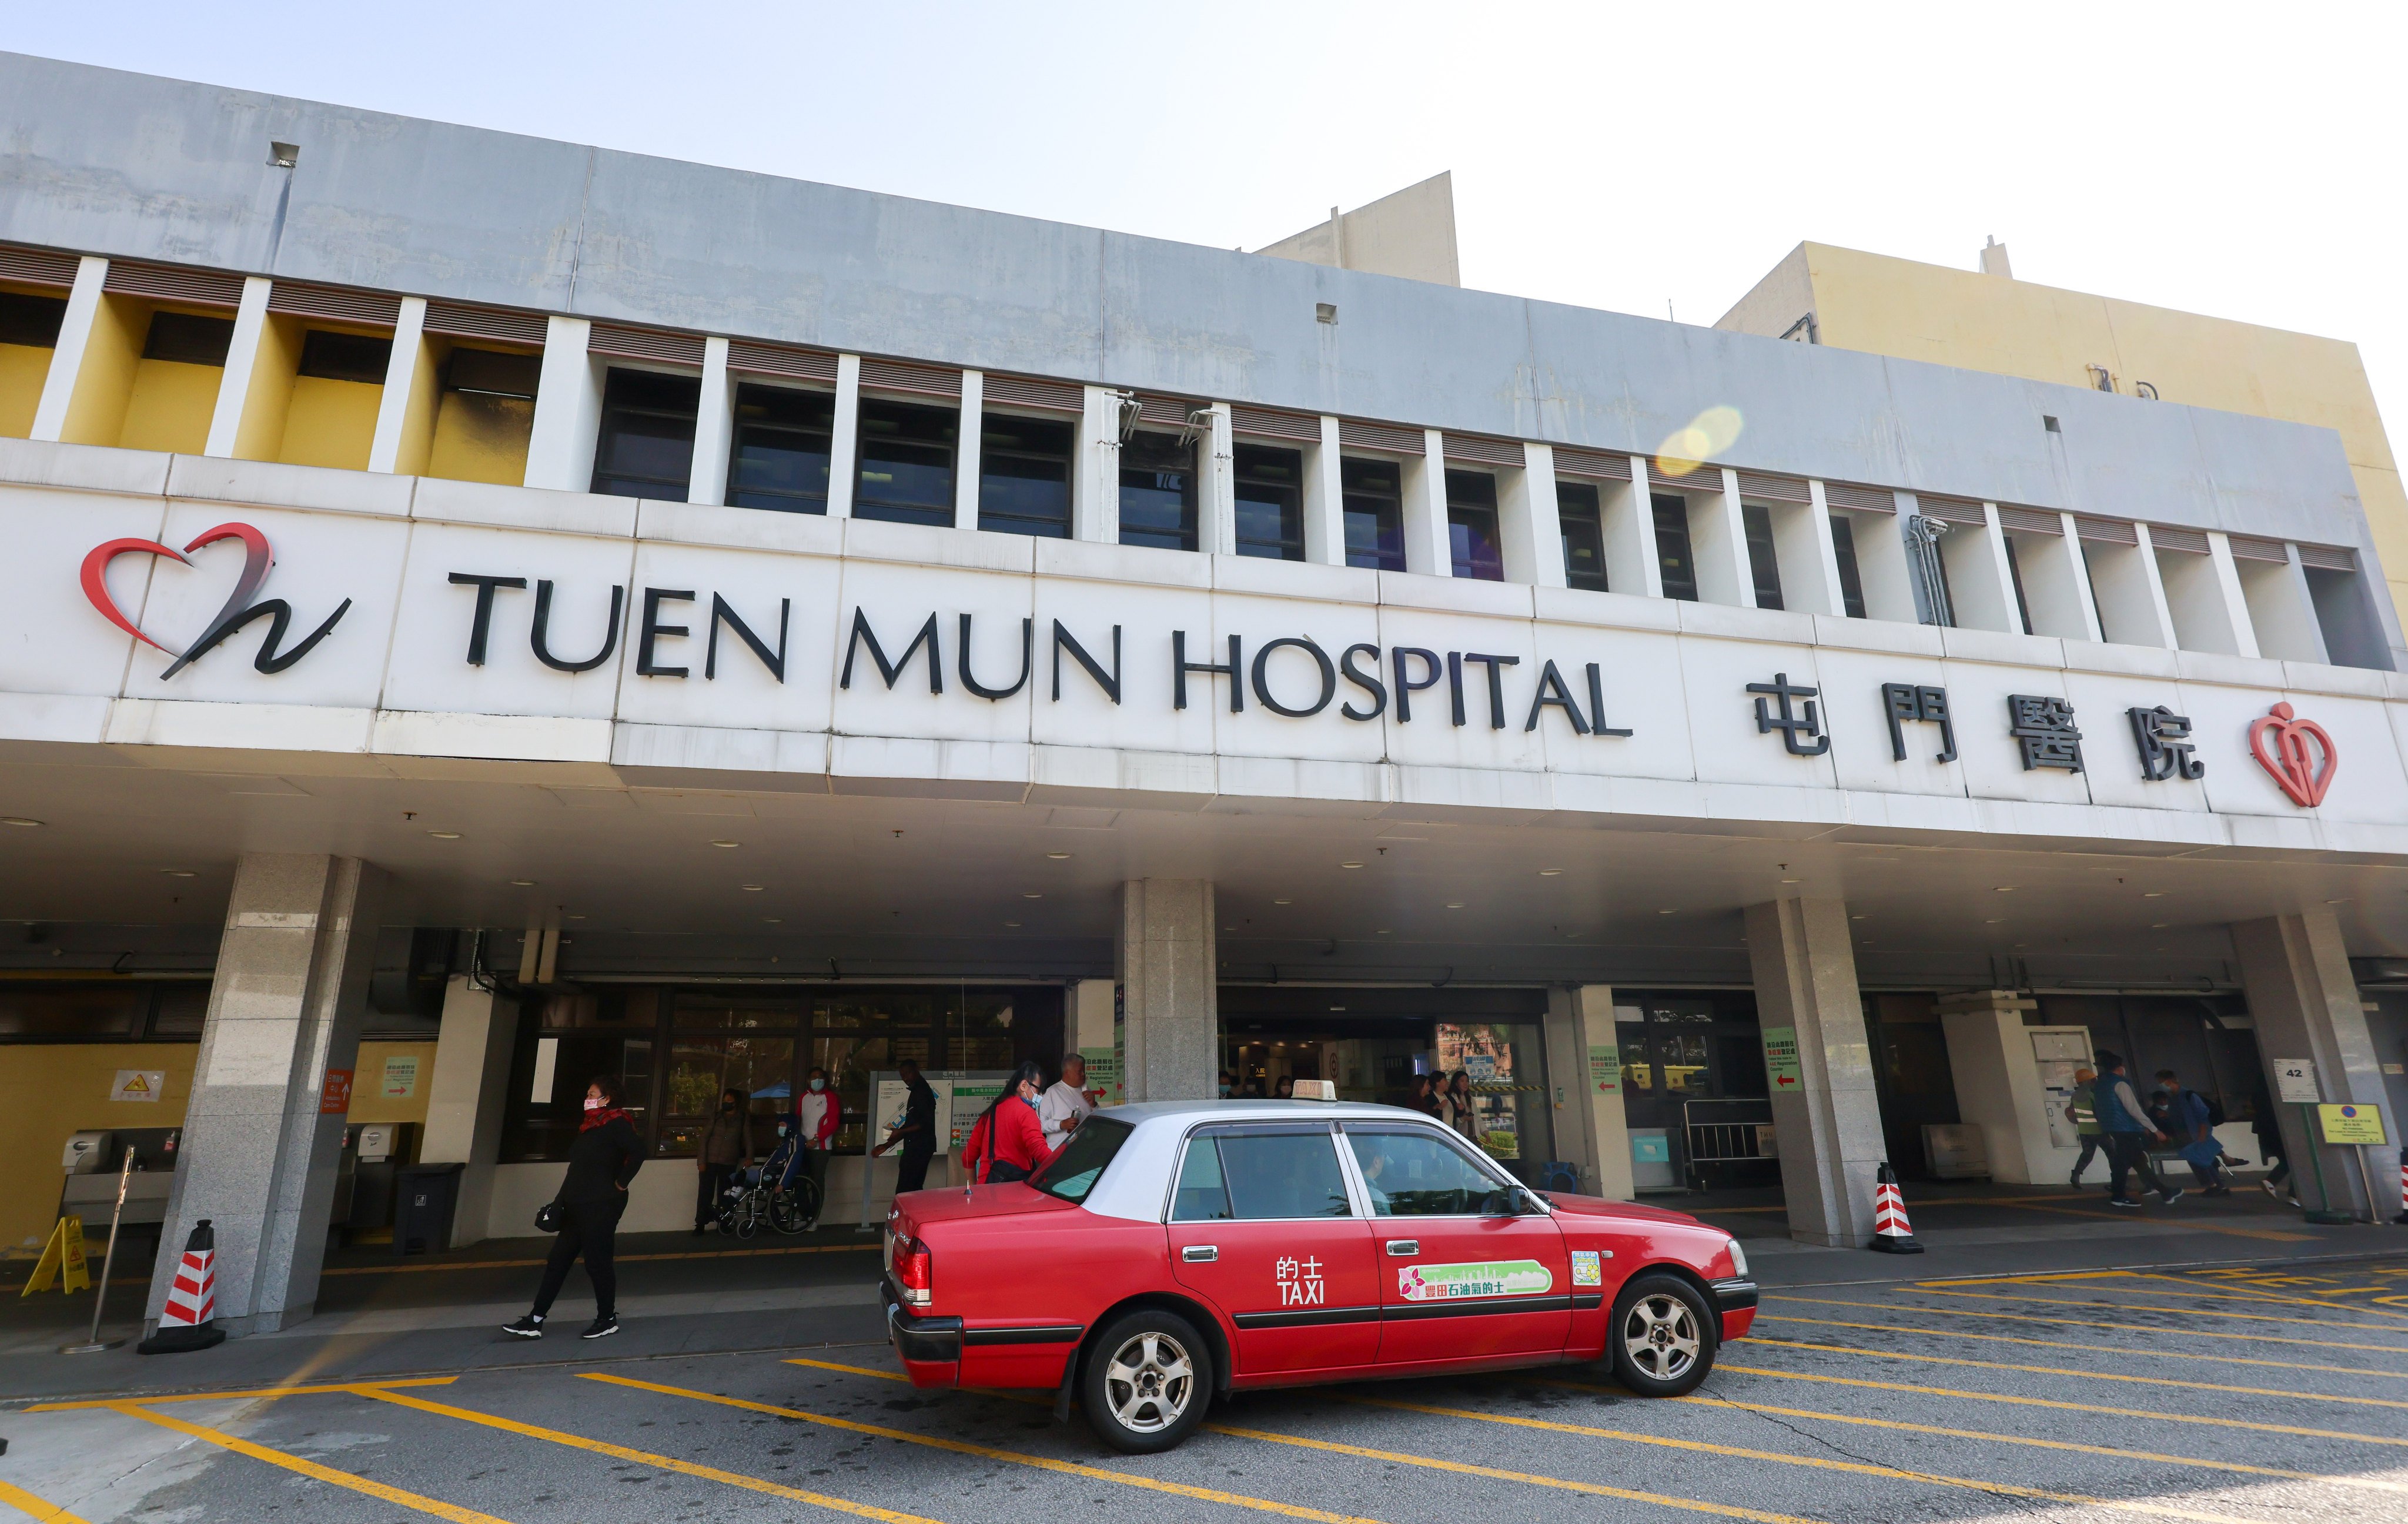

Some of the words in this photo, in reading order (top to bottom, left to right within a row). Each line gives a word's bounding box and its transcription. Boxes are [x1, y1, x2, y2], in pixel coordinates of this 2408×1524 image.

[447, 572, 790, 684] TUEN
[840, 606, 1121, 706] MUN
[1172, 630, 1634, 738] HOSPITAL
[1745, 673, 2205, 782] 屯門醫院
[1295, 1082, 1322, 1095] TAXI
[1276, 1255, 1323, 1279] 的士
[1277, 1280, 1324, 1305] TAXI
[1425, 1281, 1504, 1298] 豐田石油氣的士
